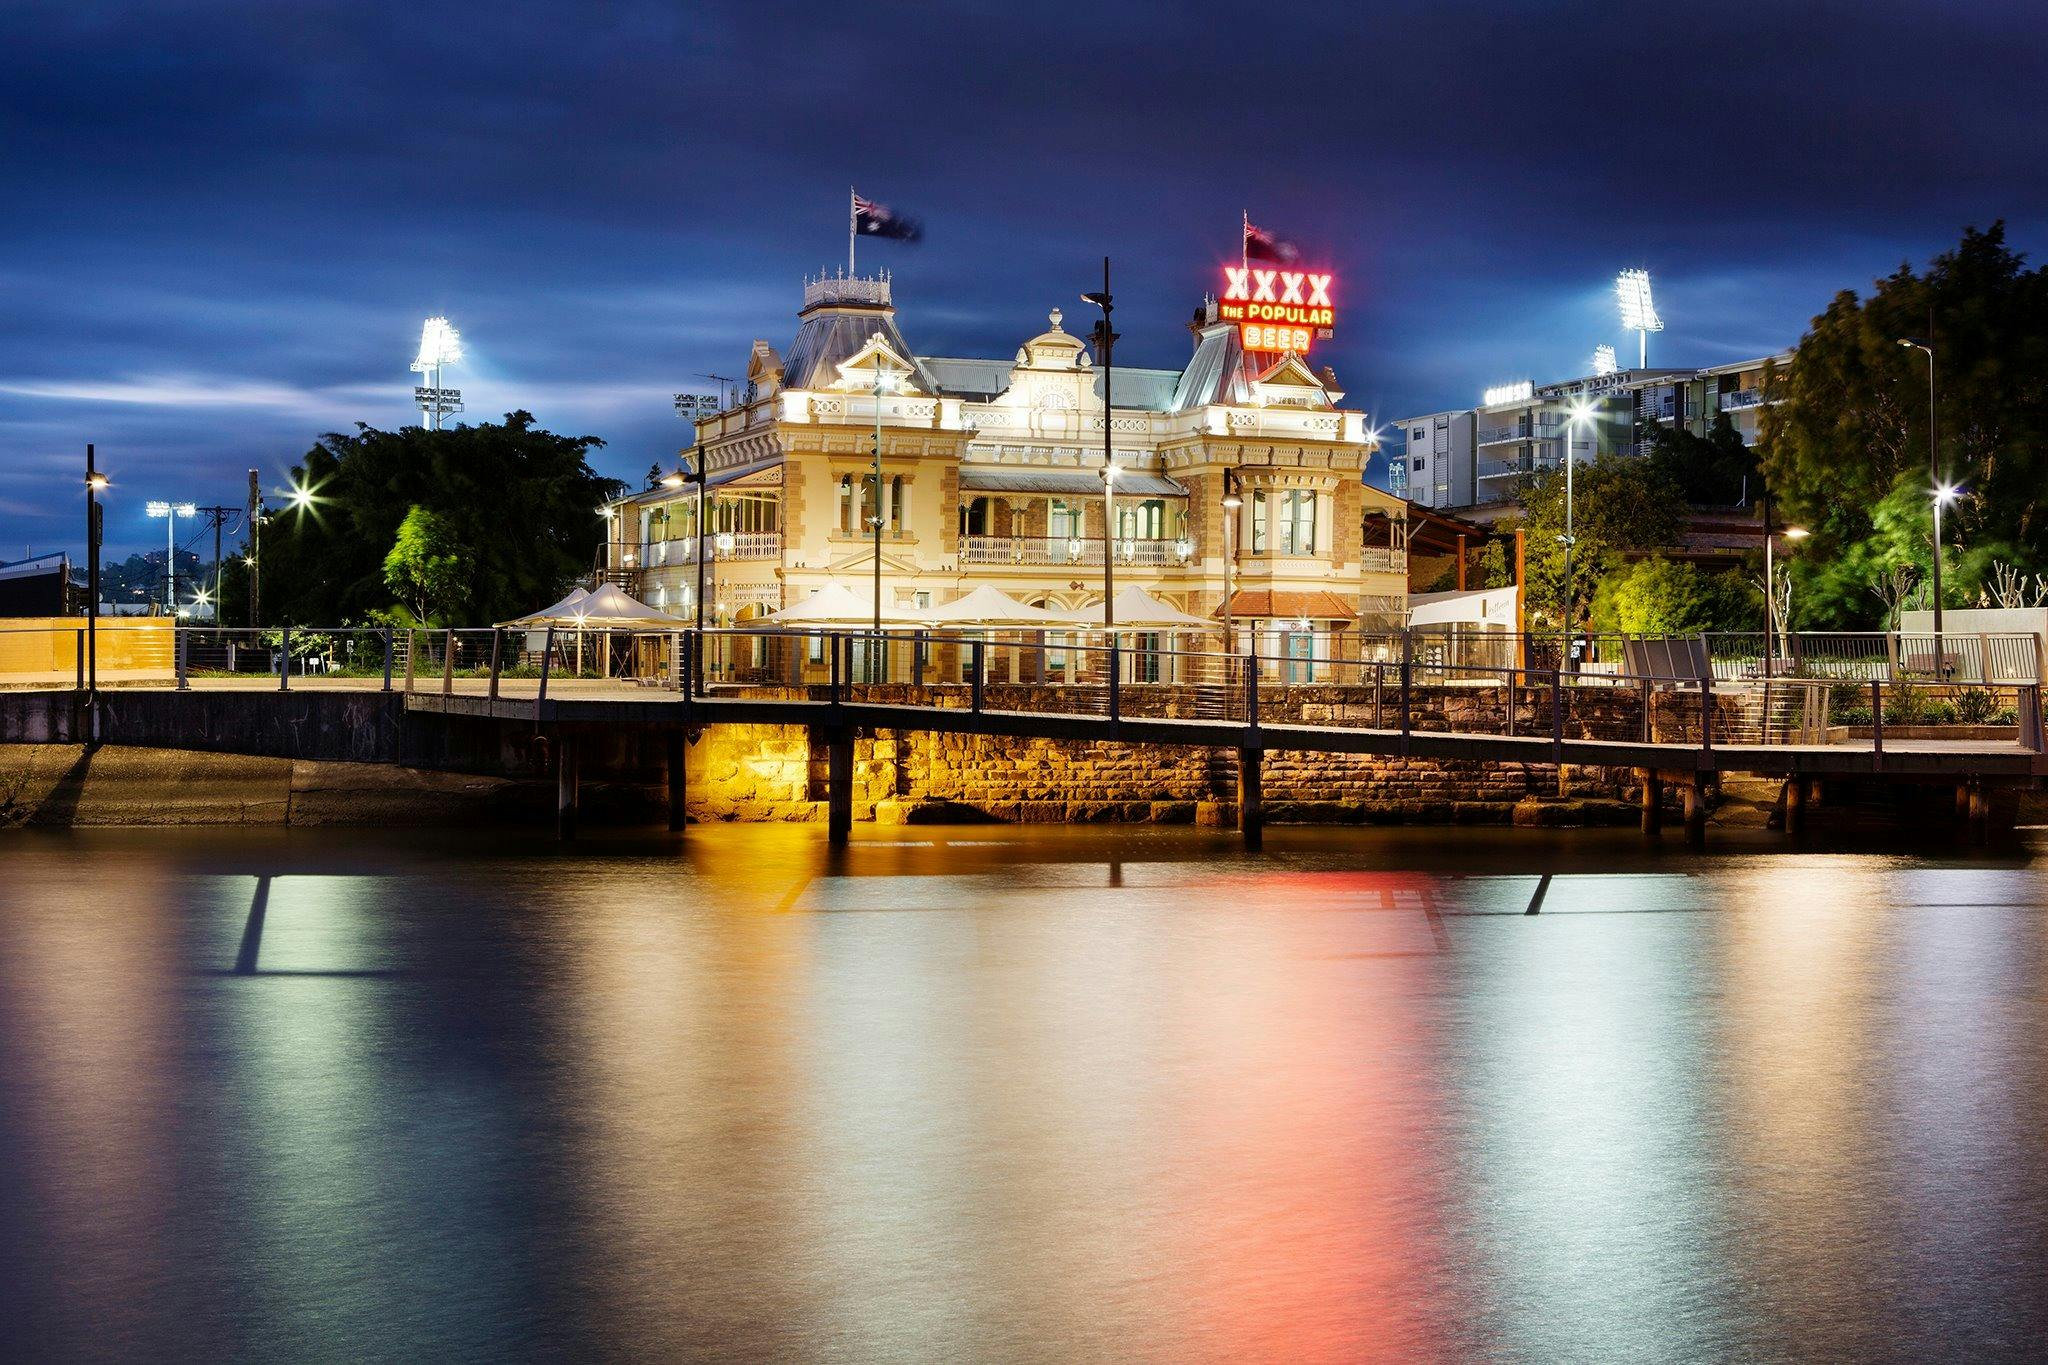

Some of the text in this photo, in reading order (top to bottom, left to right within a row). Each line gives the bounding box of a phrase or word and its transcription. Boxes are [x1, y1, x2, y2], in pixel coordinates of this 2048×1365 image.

[1224, 267, 1332, 307] XXXX
[1222, 304, 1333, 325] THE POPULAR
[1245, 326, 1310, 351] BEER
[1485, 382, 1531, 406] QUEST
